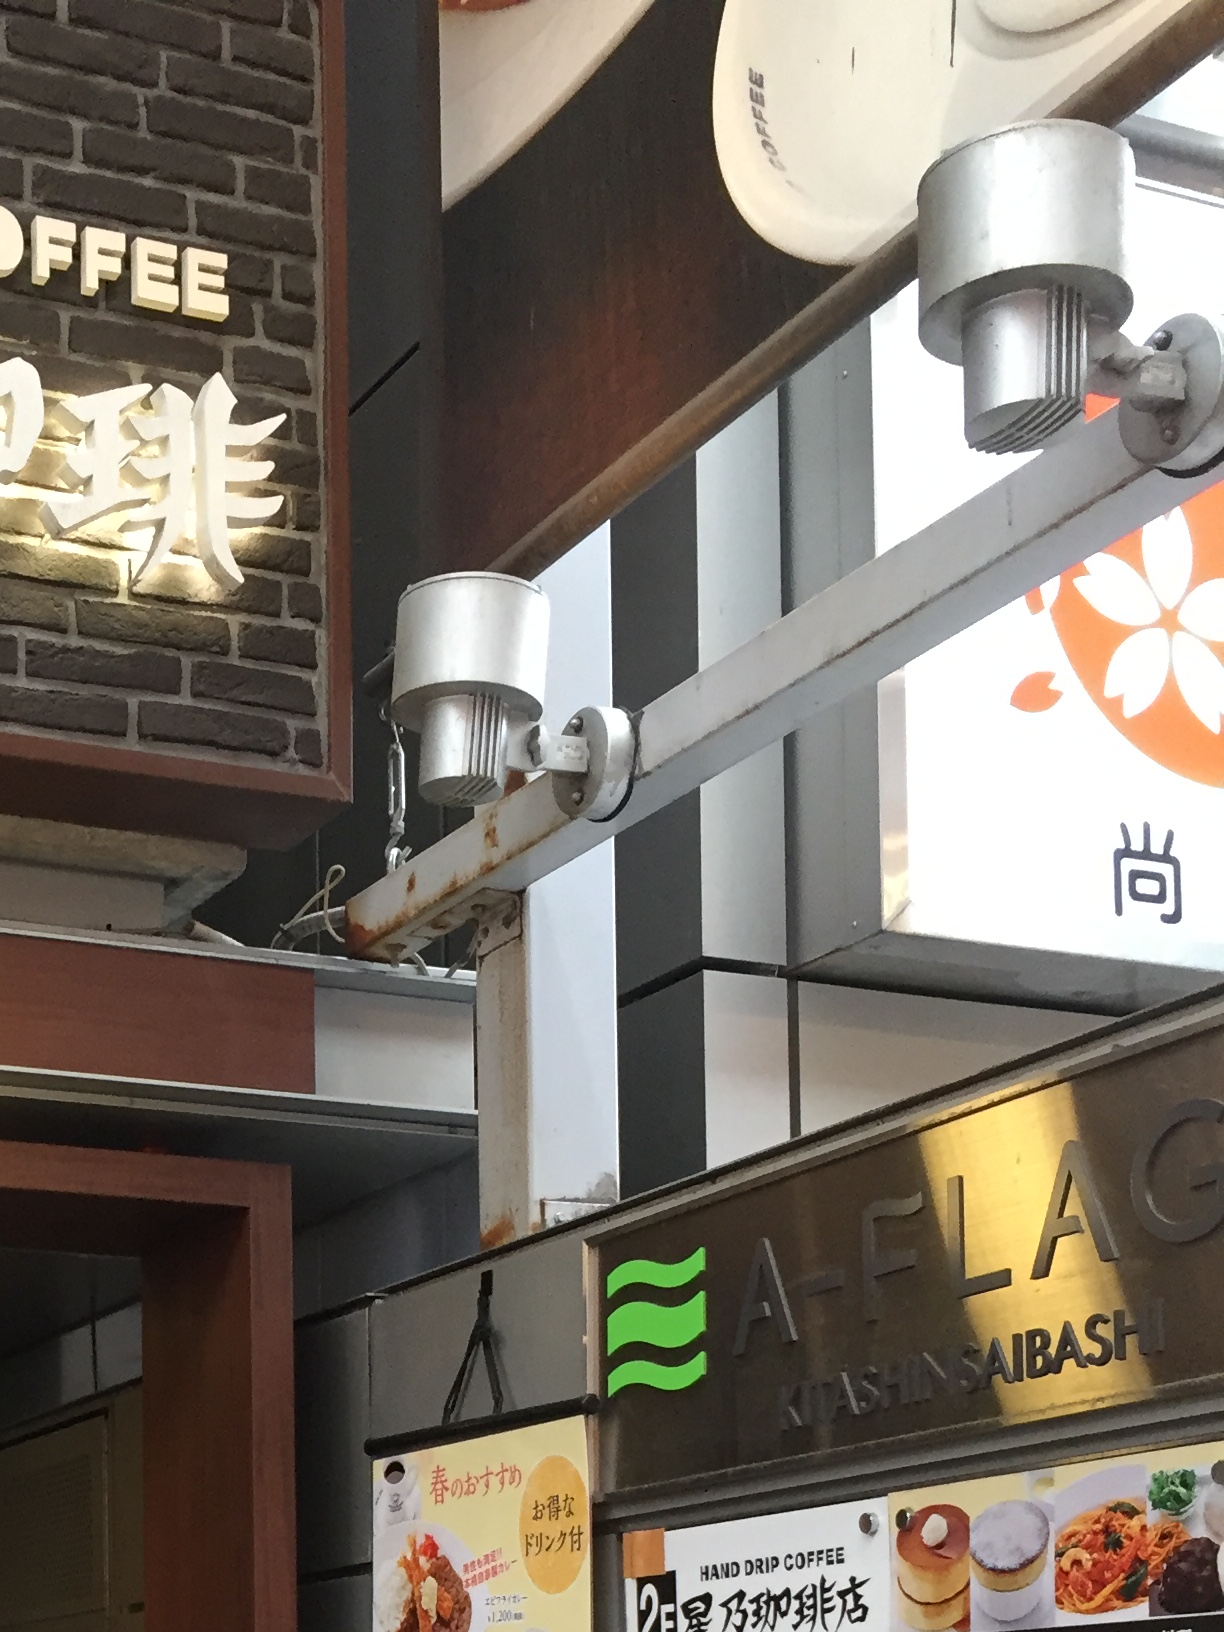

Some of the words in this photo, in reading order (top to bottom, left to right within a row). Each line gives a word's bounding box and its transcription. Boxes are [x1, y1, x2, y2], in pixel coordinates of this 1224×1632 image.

[748, 67, 786, 171] COFFEE
[1113, 822, 1182, 924] 尚
[732, 1098, 1224, 1357] A-FLAG
[780, 1299, 1166, 1434] KITASHINSAIBASHI
[429, 1462, 522, 1506] 春のおすすめ
[531, 1494, 576, 1521] お得な
[525, 1524, 585, 1557] ドリンク付
[700, 1561, 740, 1581] HAND
[744, 1556, 779, 1576] DRIP
[784, 1547, 845, 1571] COFFEE
